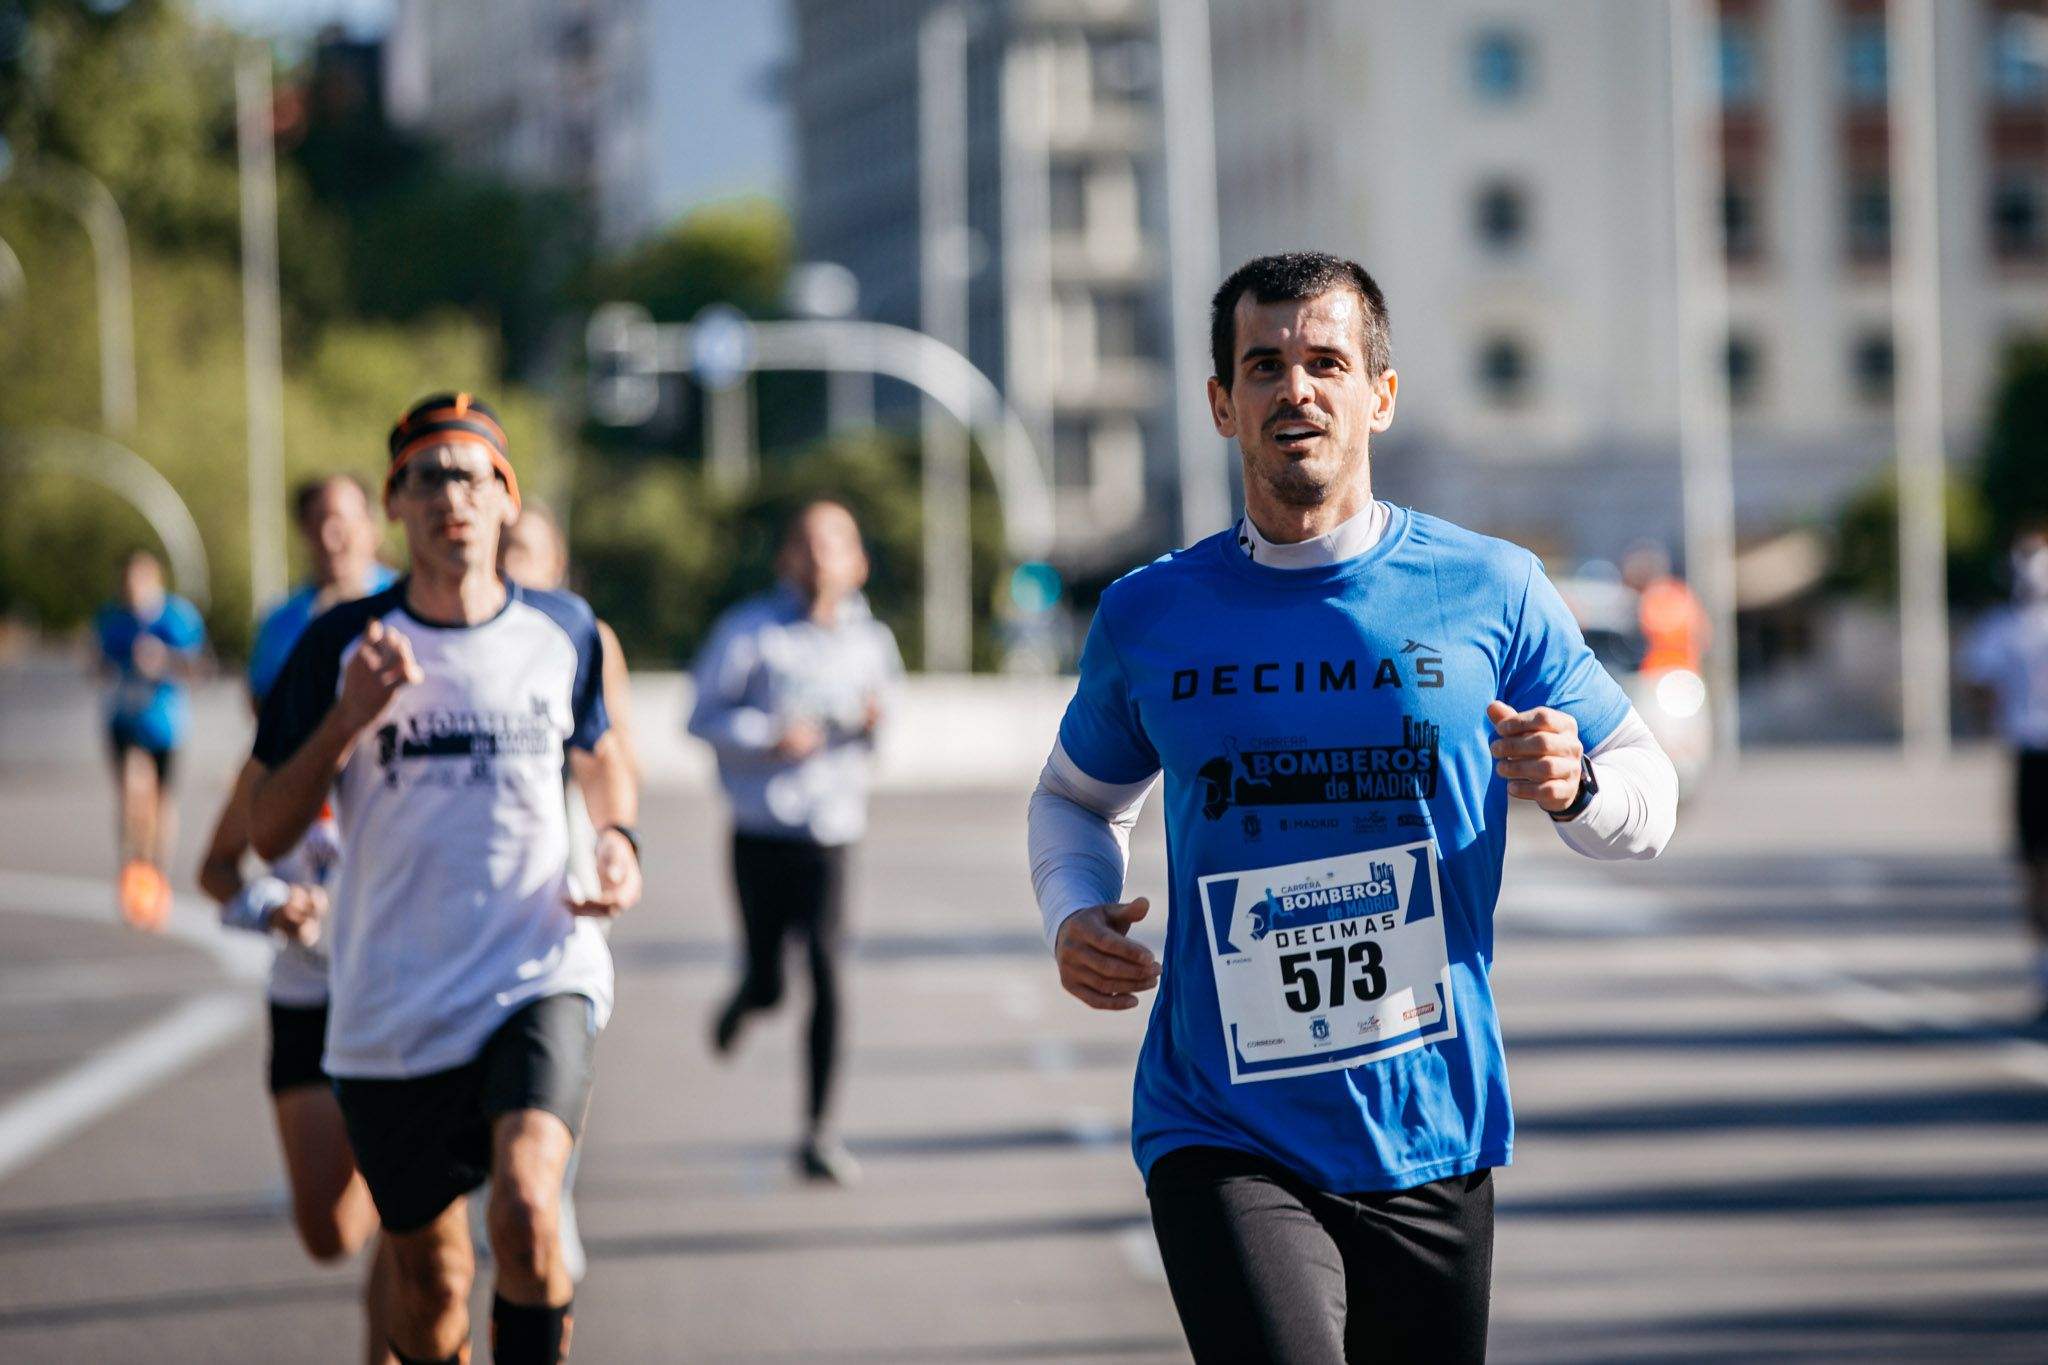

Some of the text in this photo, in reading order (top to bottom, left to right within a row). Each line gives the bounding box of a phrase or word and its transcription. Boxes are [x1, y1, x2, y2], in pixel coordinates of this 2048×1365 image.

[1172, 657, 1444, 700] DECIMAS
[1253, 749, 1431, 775] BOMBEROS
[1325, 774, 1431, 799] de MADRID
[1281, 880, 1321, 894] CARRERA
[1282, 879, 1392, 912] BOMBEROS
[1346, 896, 1395, 915] MADRID
[1276, 914, 1395, 948] DECIMAS
[1280, 941, 1388, 1013] 573
